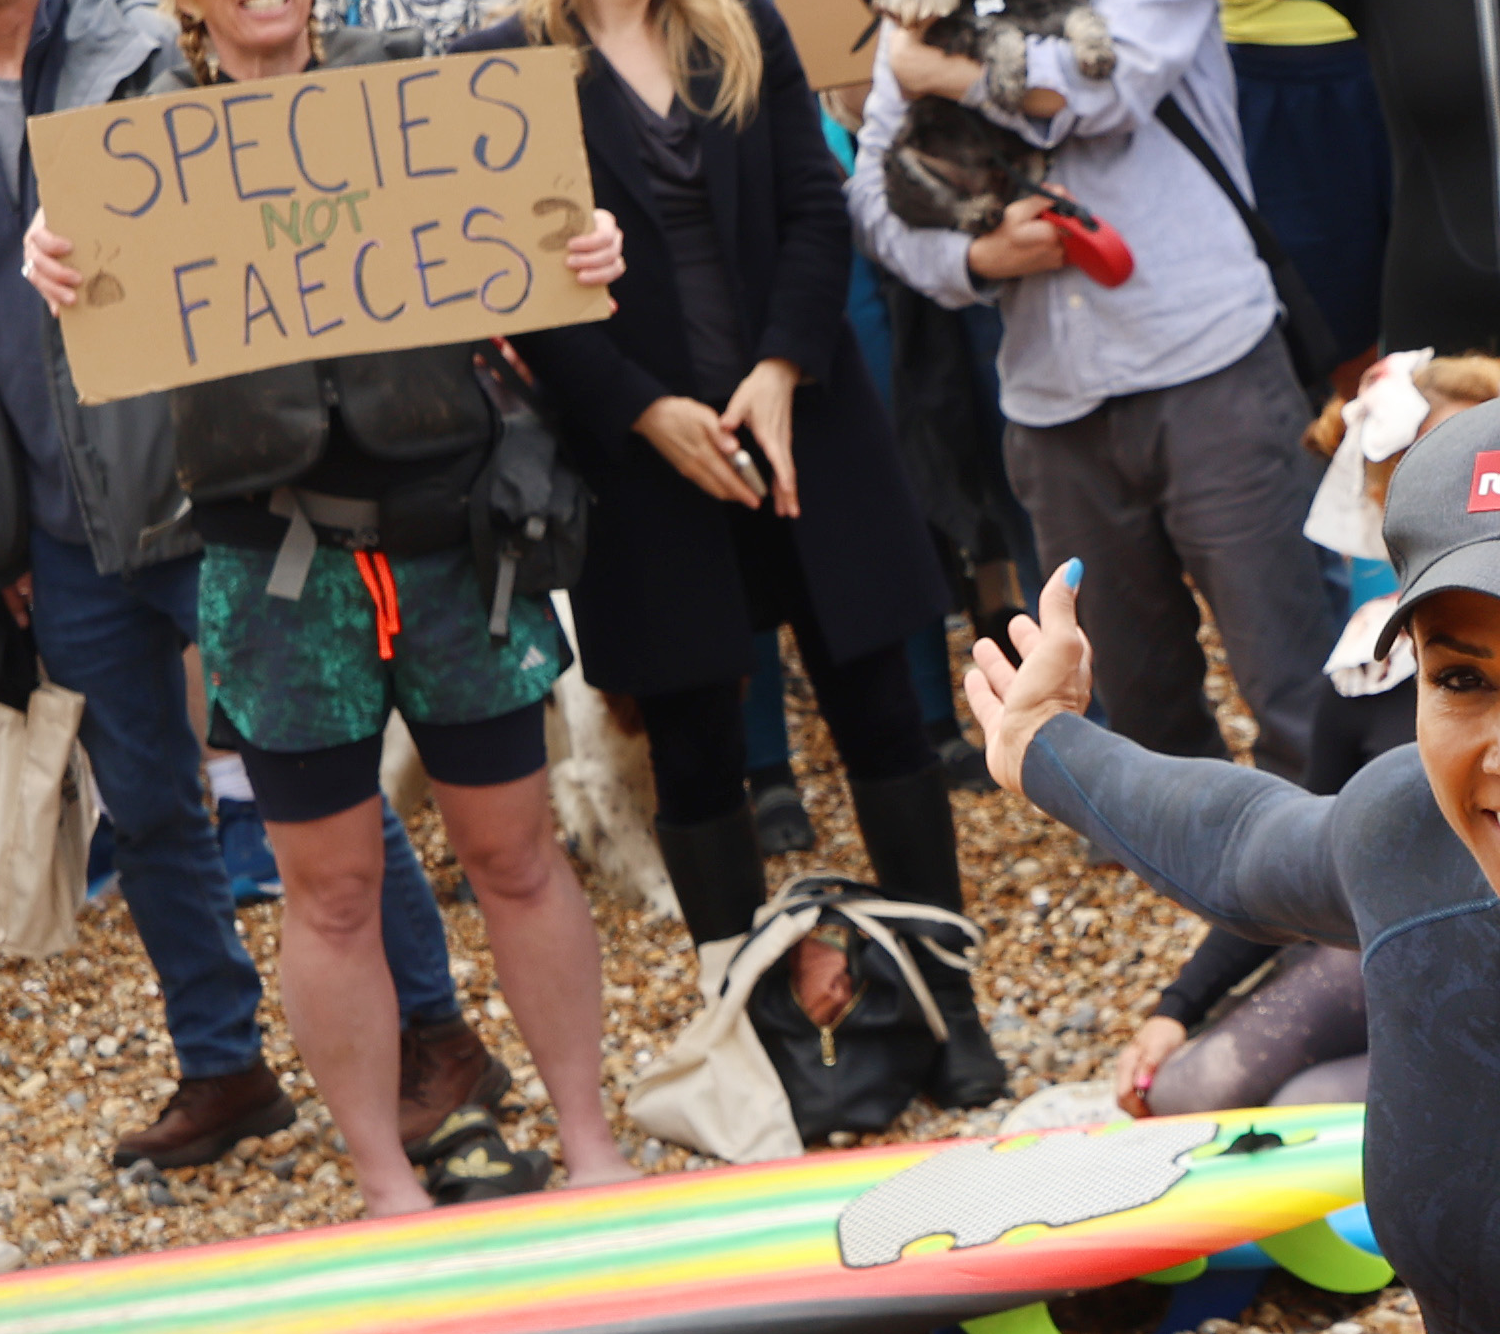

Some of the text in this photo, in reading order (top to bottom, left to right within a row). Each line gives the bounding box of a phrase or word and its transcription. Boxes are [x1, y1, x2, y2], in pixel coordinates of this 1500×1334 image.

[103, 57, 530, 219] SPECIES
[172, 207, 533, 367] FAECES
[260, 190, 369, 251] NOT
